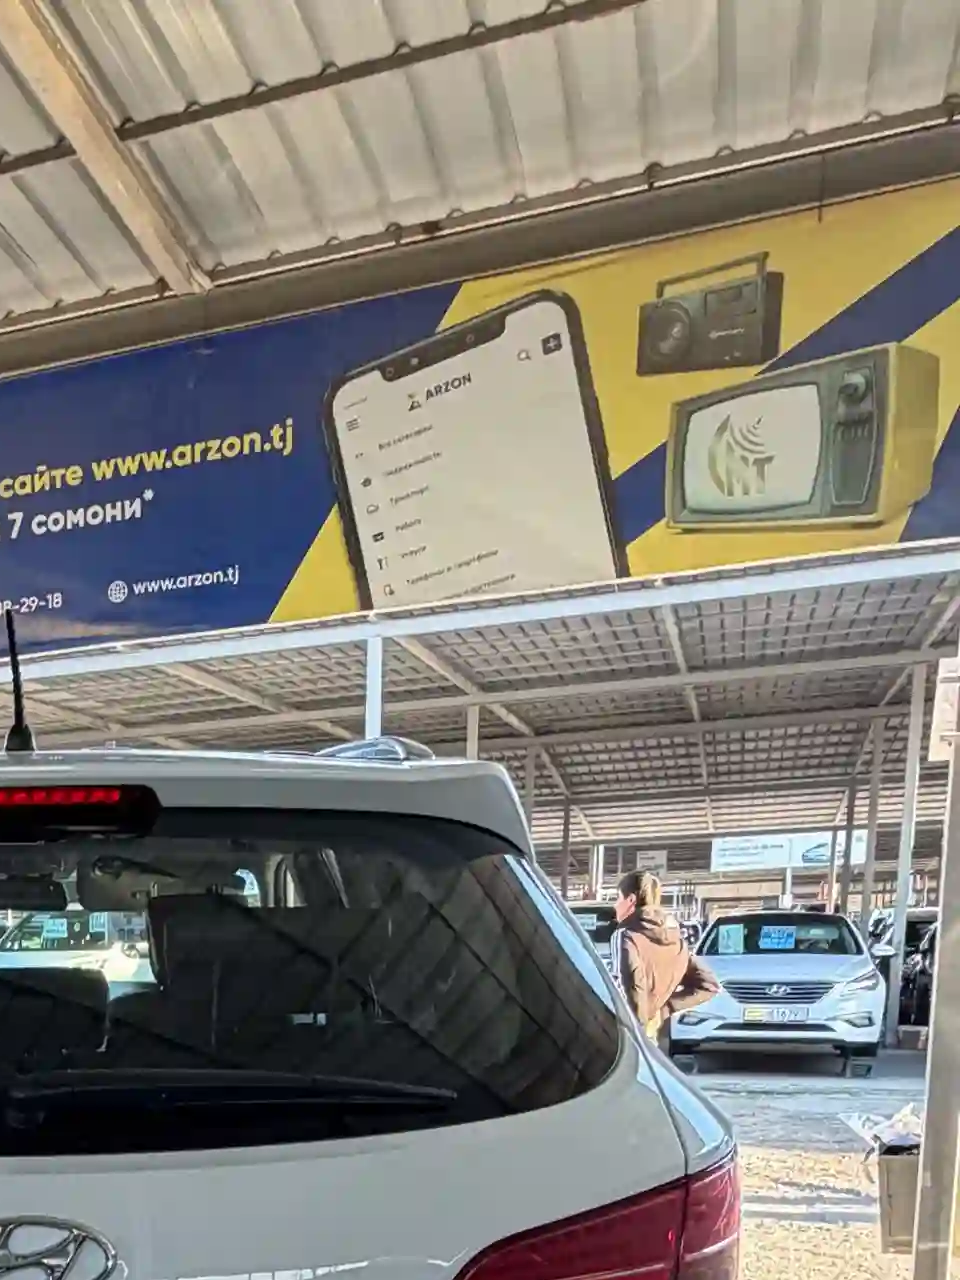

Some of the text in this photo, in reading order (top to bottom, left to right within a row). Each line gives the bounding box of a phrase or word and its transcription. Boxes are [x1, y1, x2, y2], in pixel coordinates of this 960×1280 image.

[424, 372, 473, 401] ARZON
[91, 417, 295, 483] www.arzon.tj
[7, 510, 24, 540] 7
[132, 564, 241, 596] www.arzon.tj
